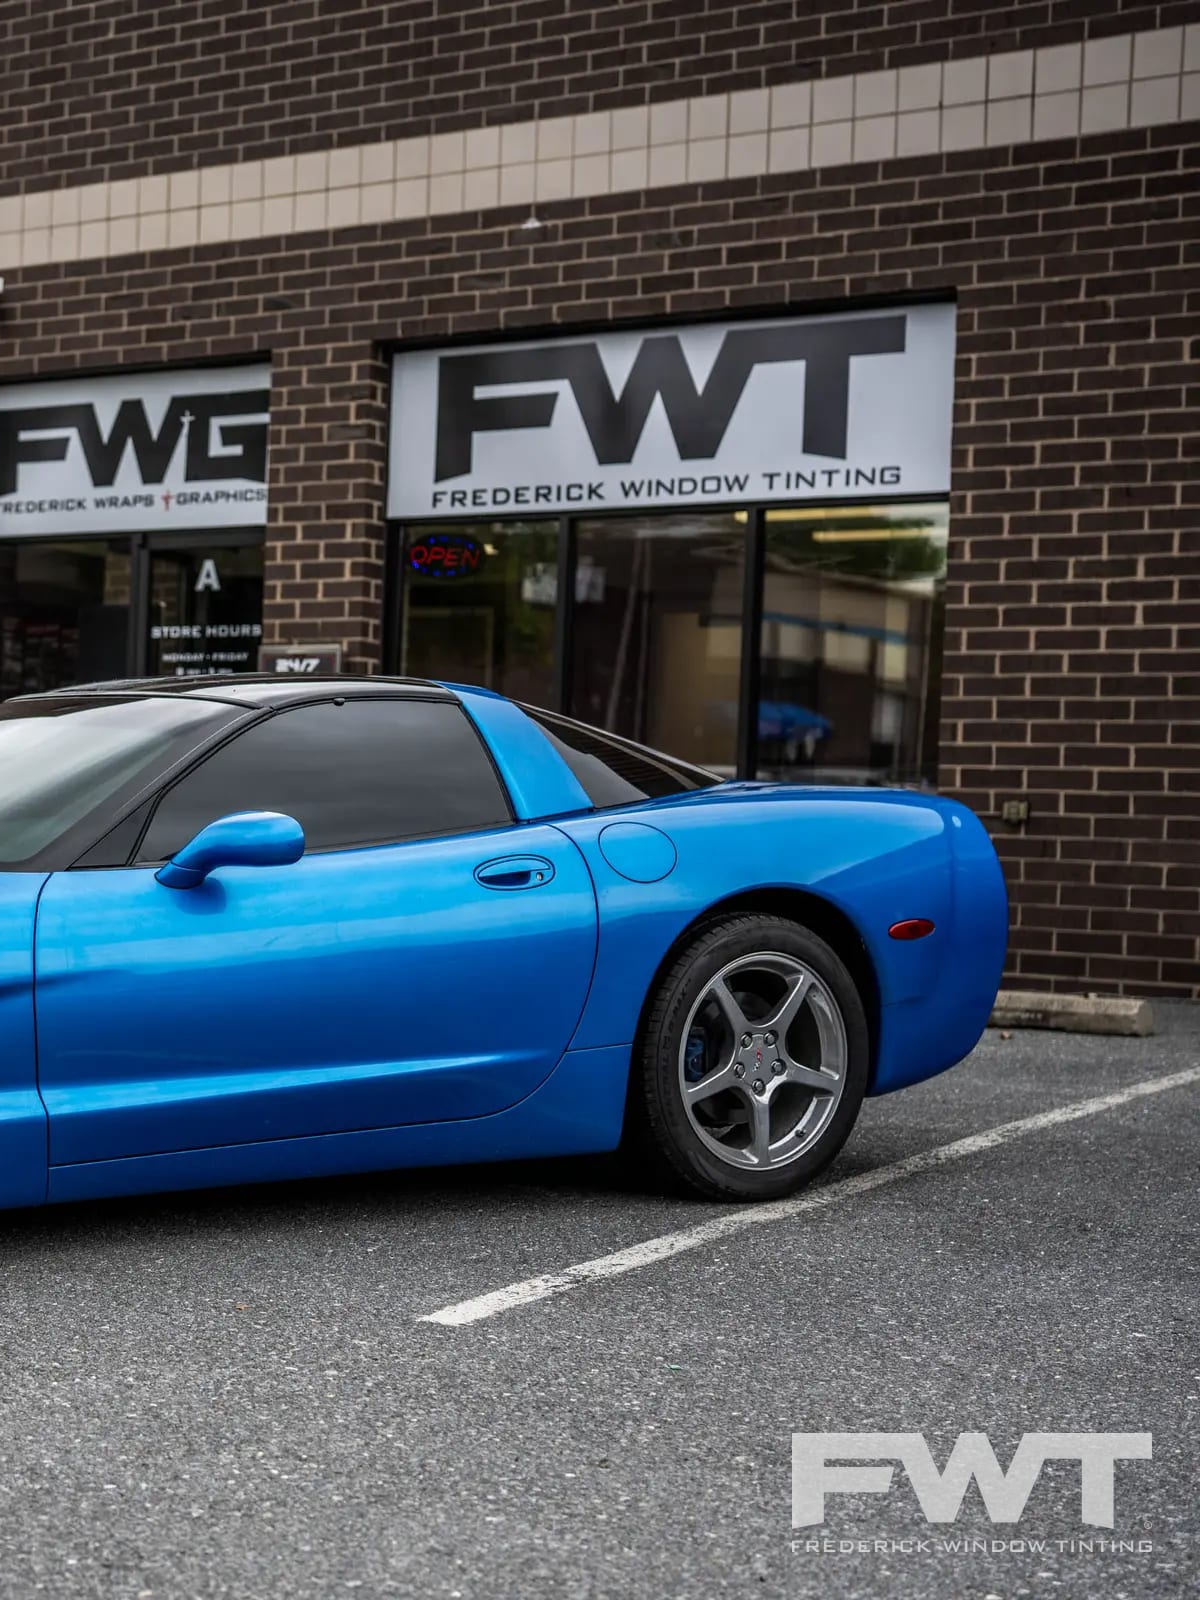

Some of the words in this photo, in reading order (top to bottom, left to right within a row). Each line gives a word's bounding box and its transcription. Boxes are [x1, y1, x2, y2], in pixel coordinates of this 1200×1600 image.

[434, 316, 906, 482] FWT
[94, 494, 154, 509] WRAPS
[175, 488, 267, 505] GRAPHICS
[432, 482, 605, 508] FREDERICK
[620, 474, 749, 498] WINDOW
[763, 466, 902, 491] TINTING
[410, 545, 480, 568] OPEN
[194, 559, 220, 591] A
[151, 626, 201, 639] STORE
[205, 624, 261, 638] HOURS
[162, 652, 204, 662] MONDAY
[211, 652, 249, 661] FRIDAY
